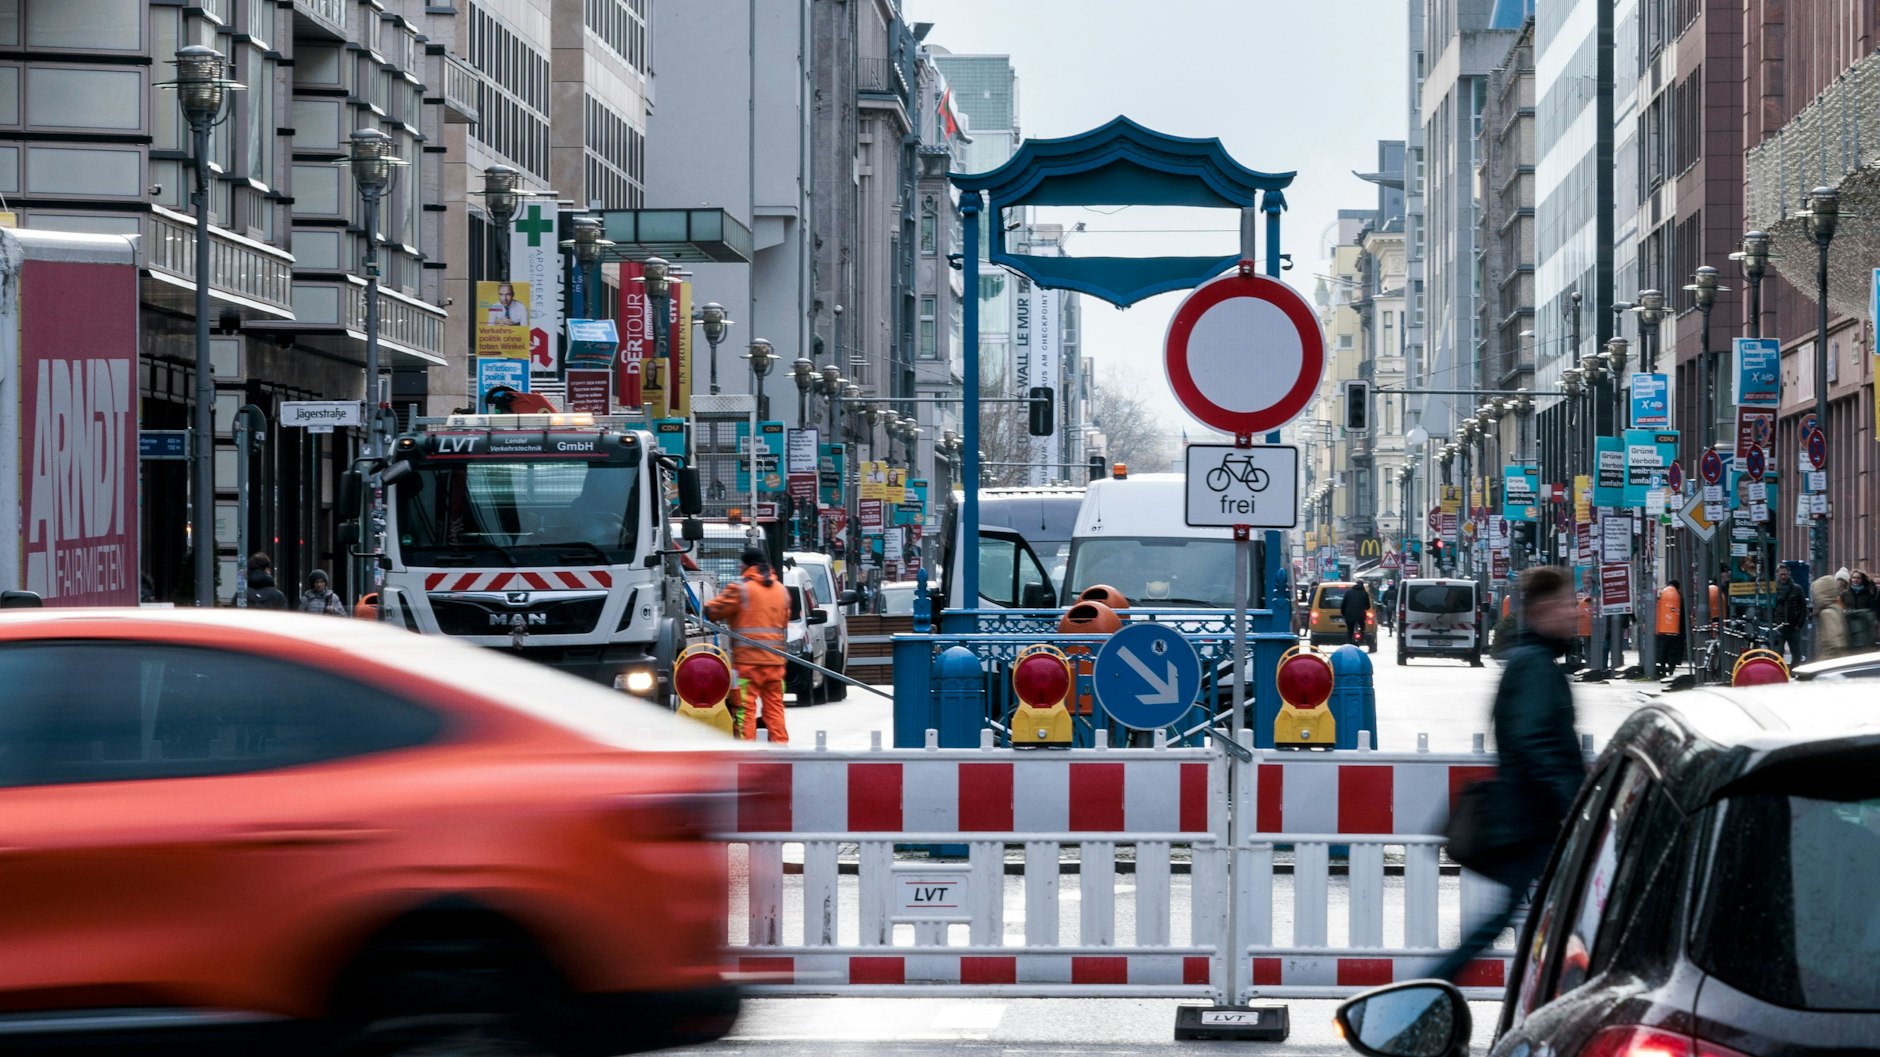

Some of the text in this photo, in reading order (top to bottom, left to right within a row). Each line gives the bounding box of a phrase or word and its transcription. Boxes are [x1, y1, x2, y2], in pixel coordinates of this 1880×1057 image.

[669, 298, 678, 324] CITY
[1017, 298, 1028, 329] MUR
[627, 294, 642, 374] DERTOUR
[1017, 332, 1028, 346] LE
[1042, 354, 1048, 367] AM
[1017, 353, 1028, 388] WALL
[295, 408, 346, 420] Jägerstraße
[29, 358, 130, 544] ARNDT
[438, 437, 479, 453] LVT
[557, 442, 594, 451] GmbH
[1220, 495, 1255, 514] frei
[56, 544, 125, 597] FAIRMIETEN
[490, 613, 546, 625] MAN
[914, 888, 948, 901] LVT
